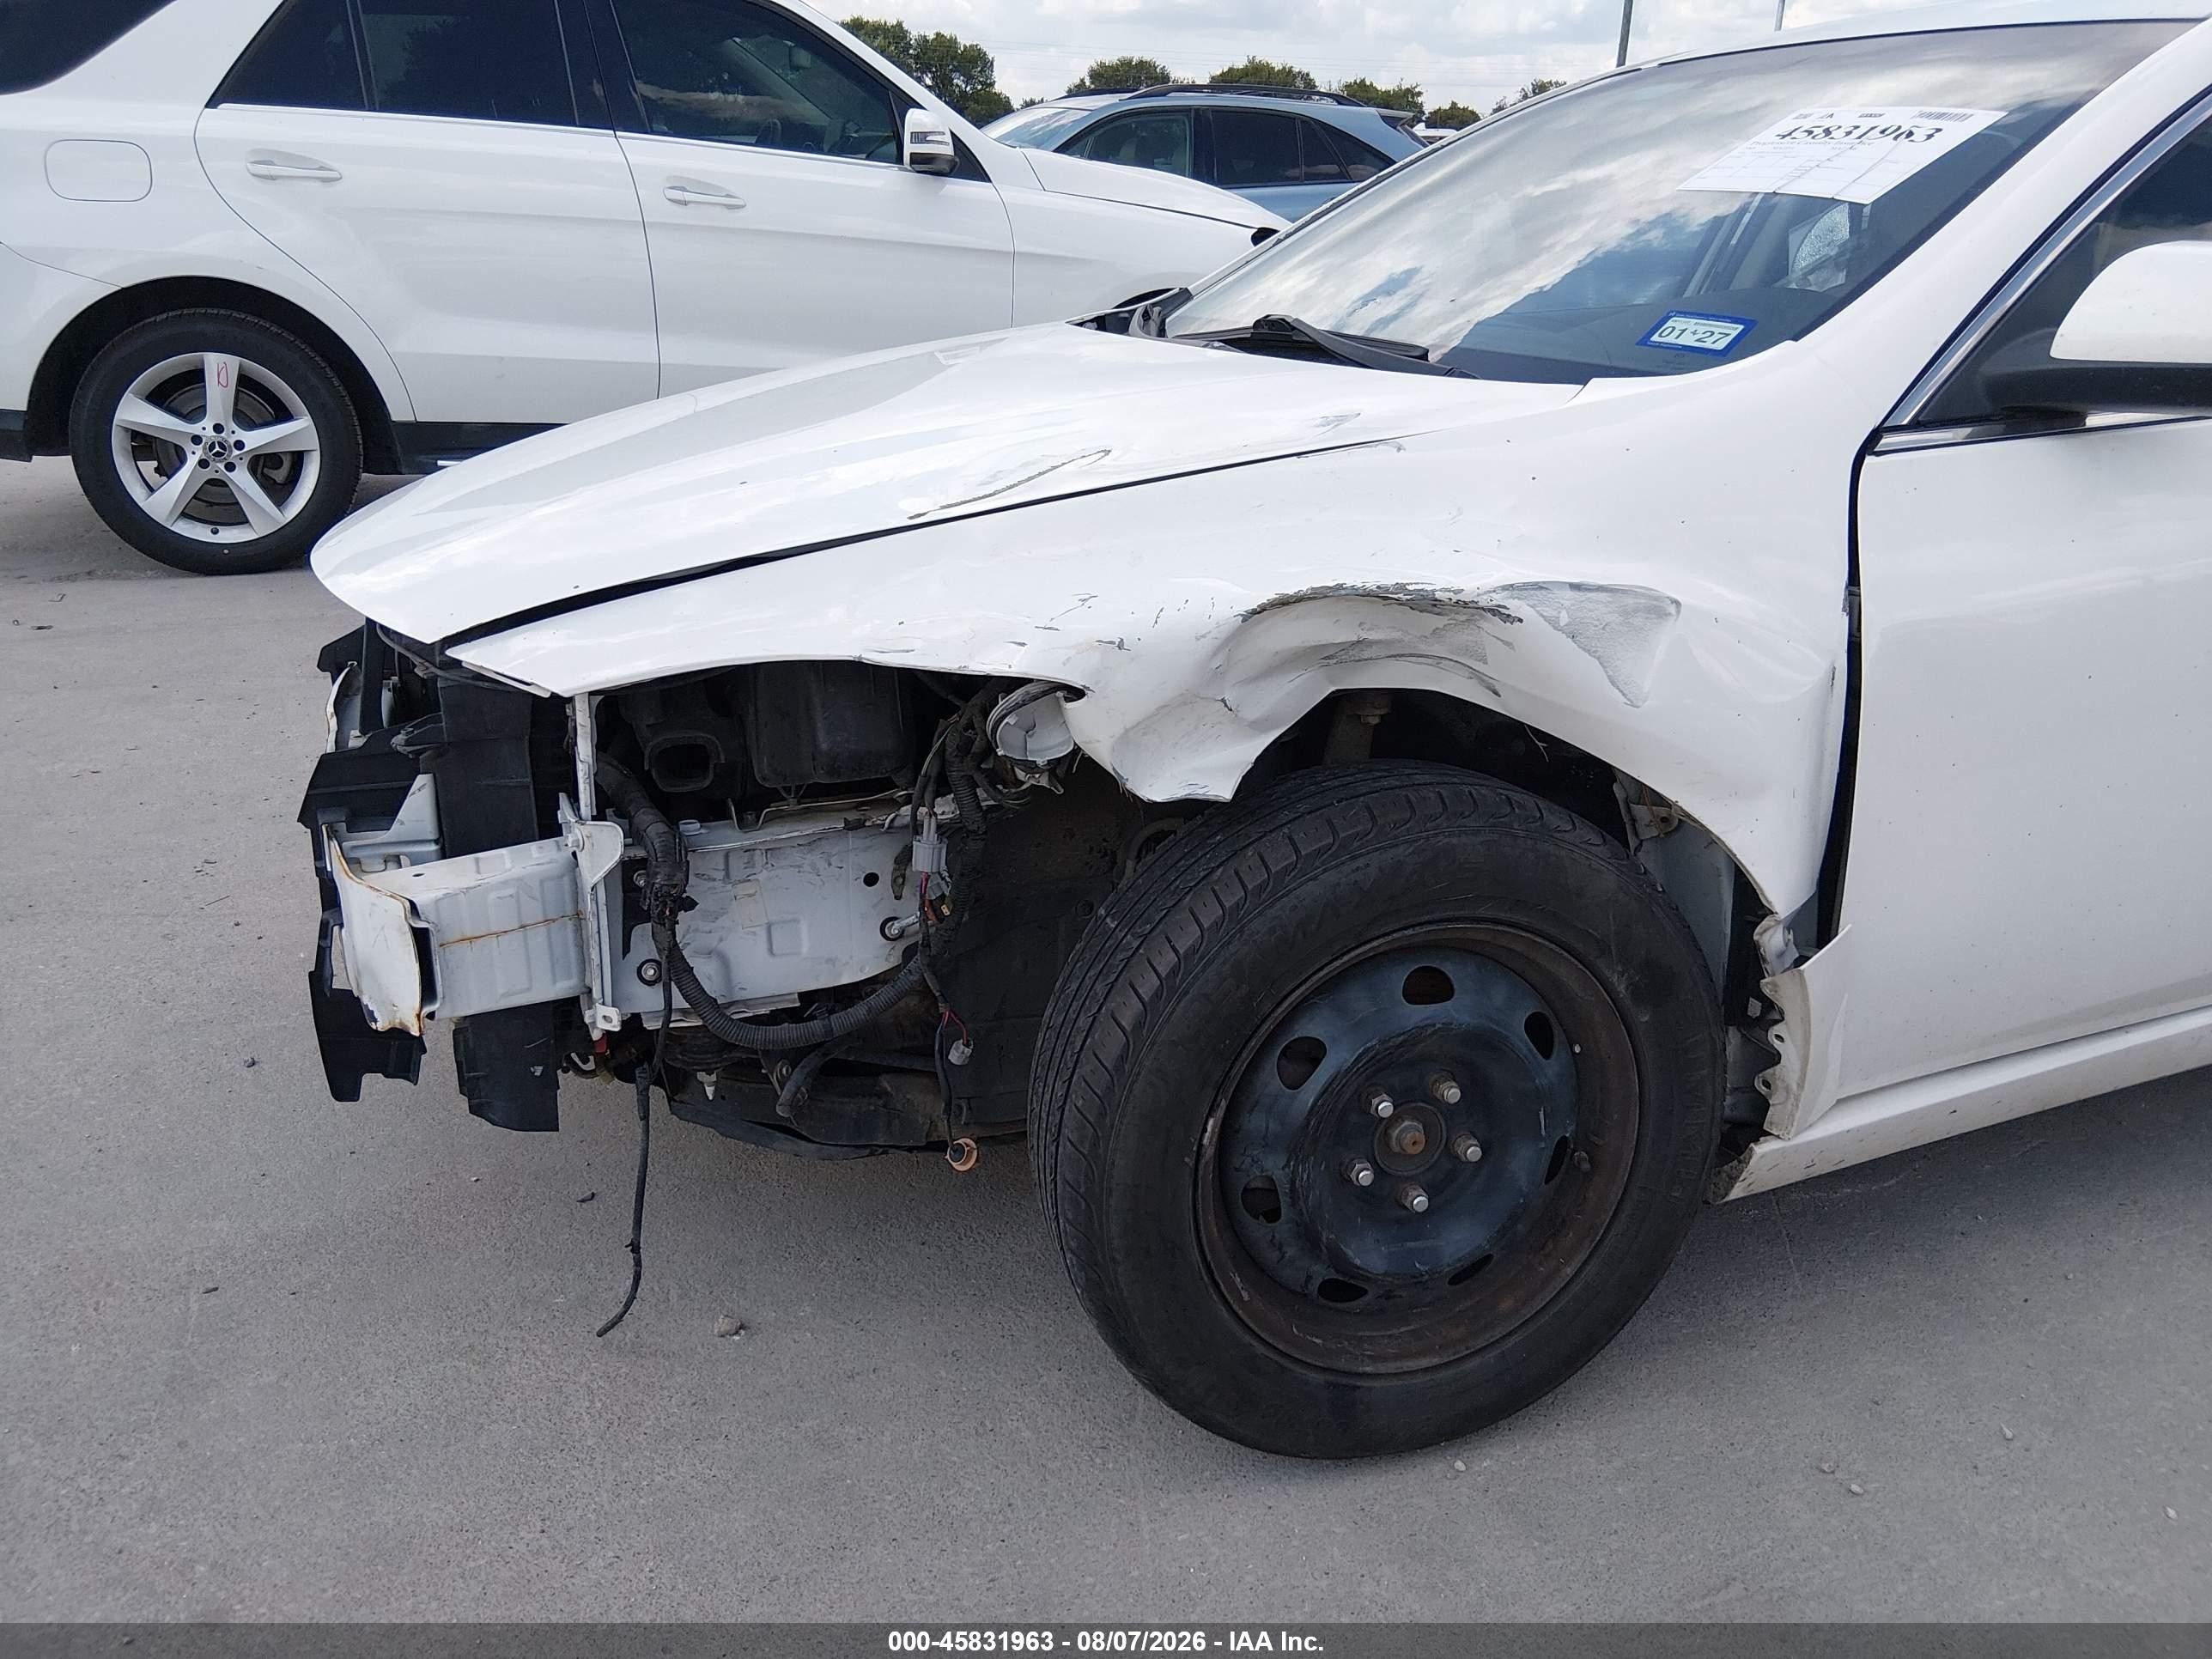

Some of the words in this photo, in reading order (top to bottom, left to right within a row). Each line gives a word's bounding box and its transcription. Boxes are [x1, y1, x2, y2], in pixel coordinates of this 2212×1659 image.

[1775, 124, 1943, 143] 45831963
[1658, 325, 1688, 339] 01
[1694, 330, 1732, 344] 27
